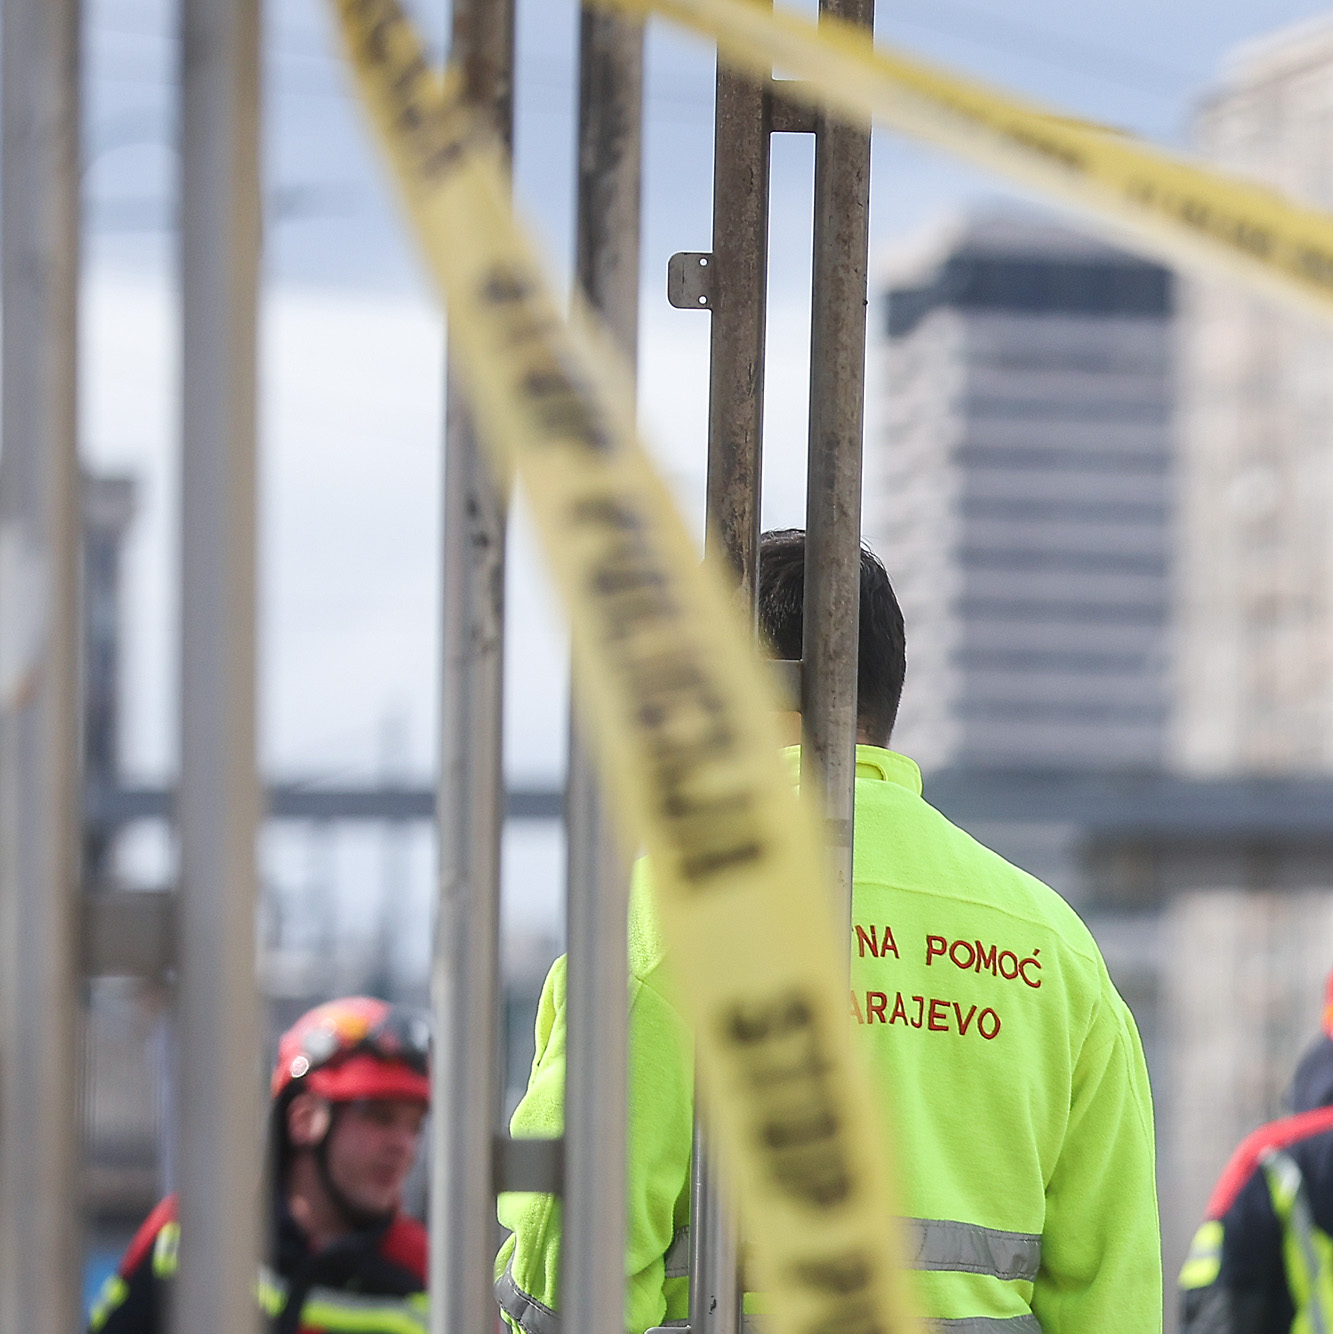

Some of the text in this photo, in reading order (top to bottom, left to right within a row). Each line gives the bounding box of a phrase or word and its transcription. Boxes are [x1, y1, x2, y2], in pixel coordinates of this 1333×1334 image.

[851, 924, 1042, 988] NA POMOĆ
[850, 990, 1001, 1040] ARAJEVO
